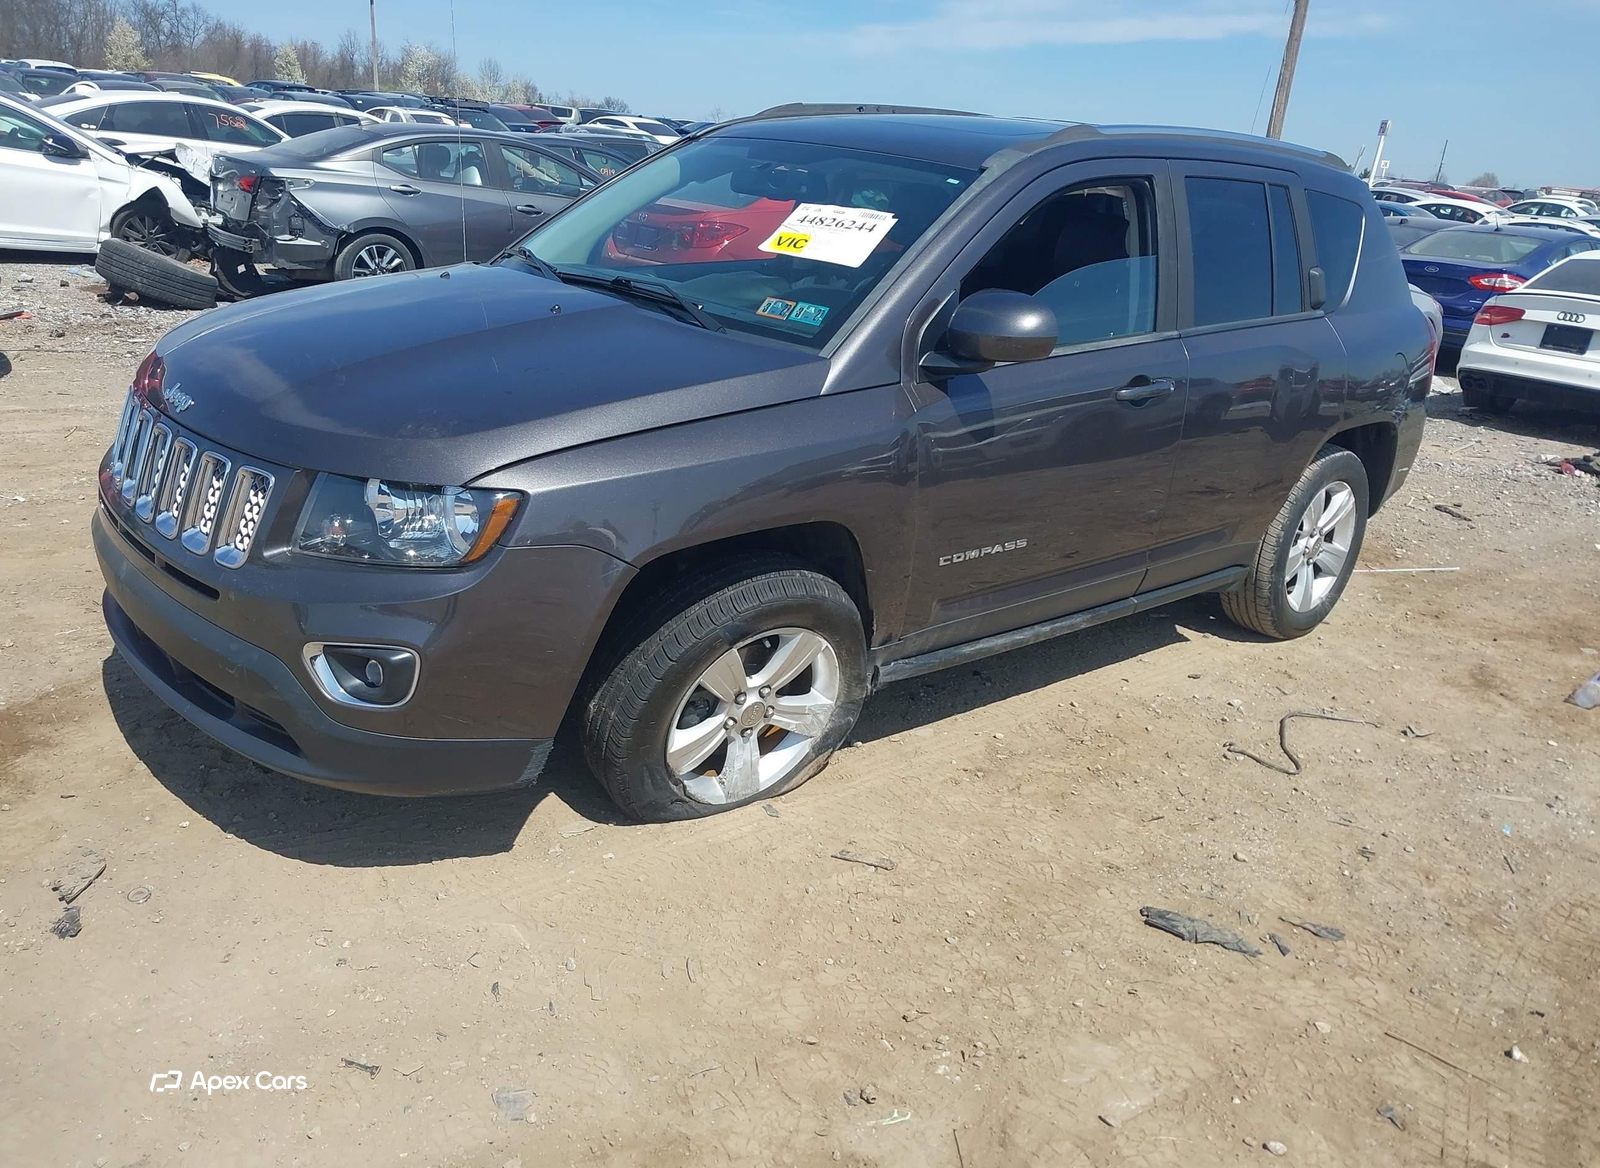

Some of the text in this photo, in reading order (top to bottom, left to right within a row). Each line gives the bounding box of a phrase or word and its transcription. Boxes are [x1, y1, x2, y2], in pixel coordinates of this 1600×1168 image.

[797, 214, 877, 233] 44826244
[776, 236, 808, 249] VIC
[164, 382, 193, 413] Jeep
[939, 538, 1028, 566] COMPASS
